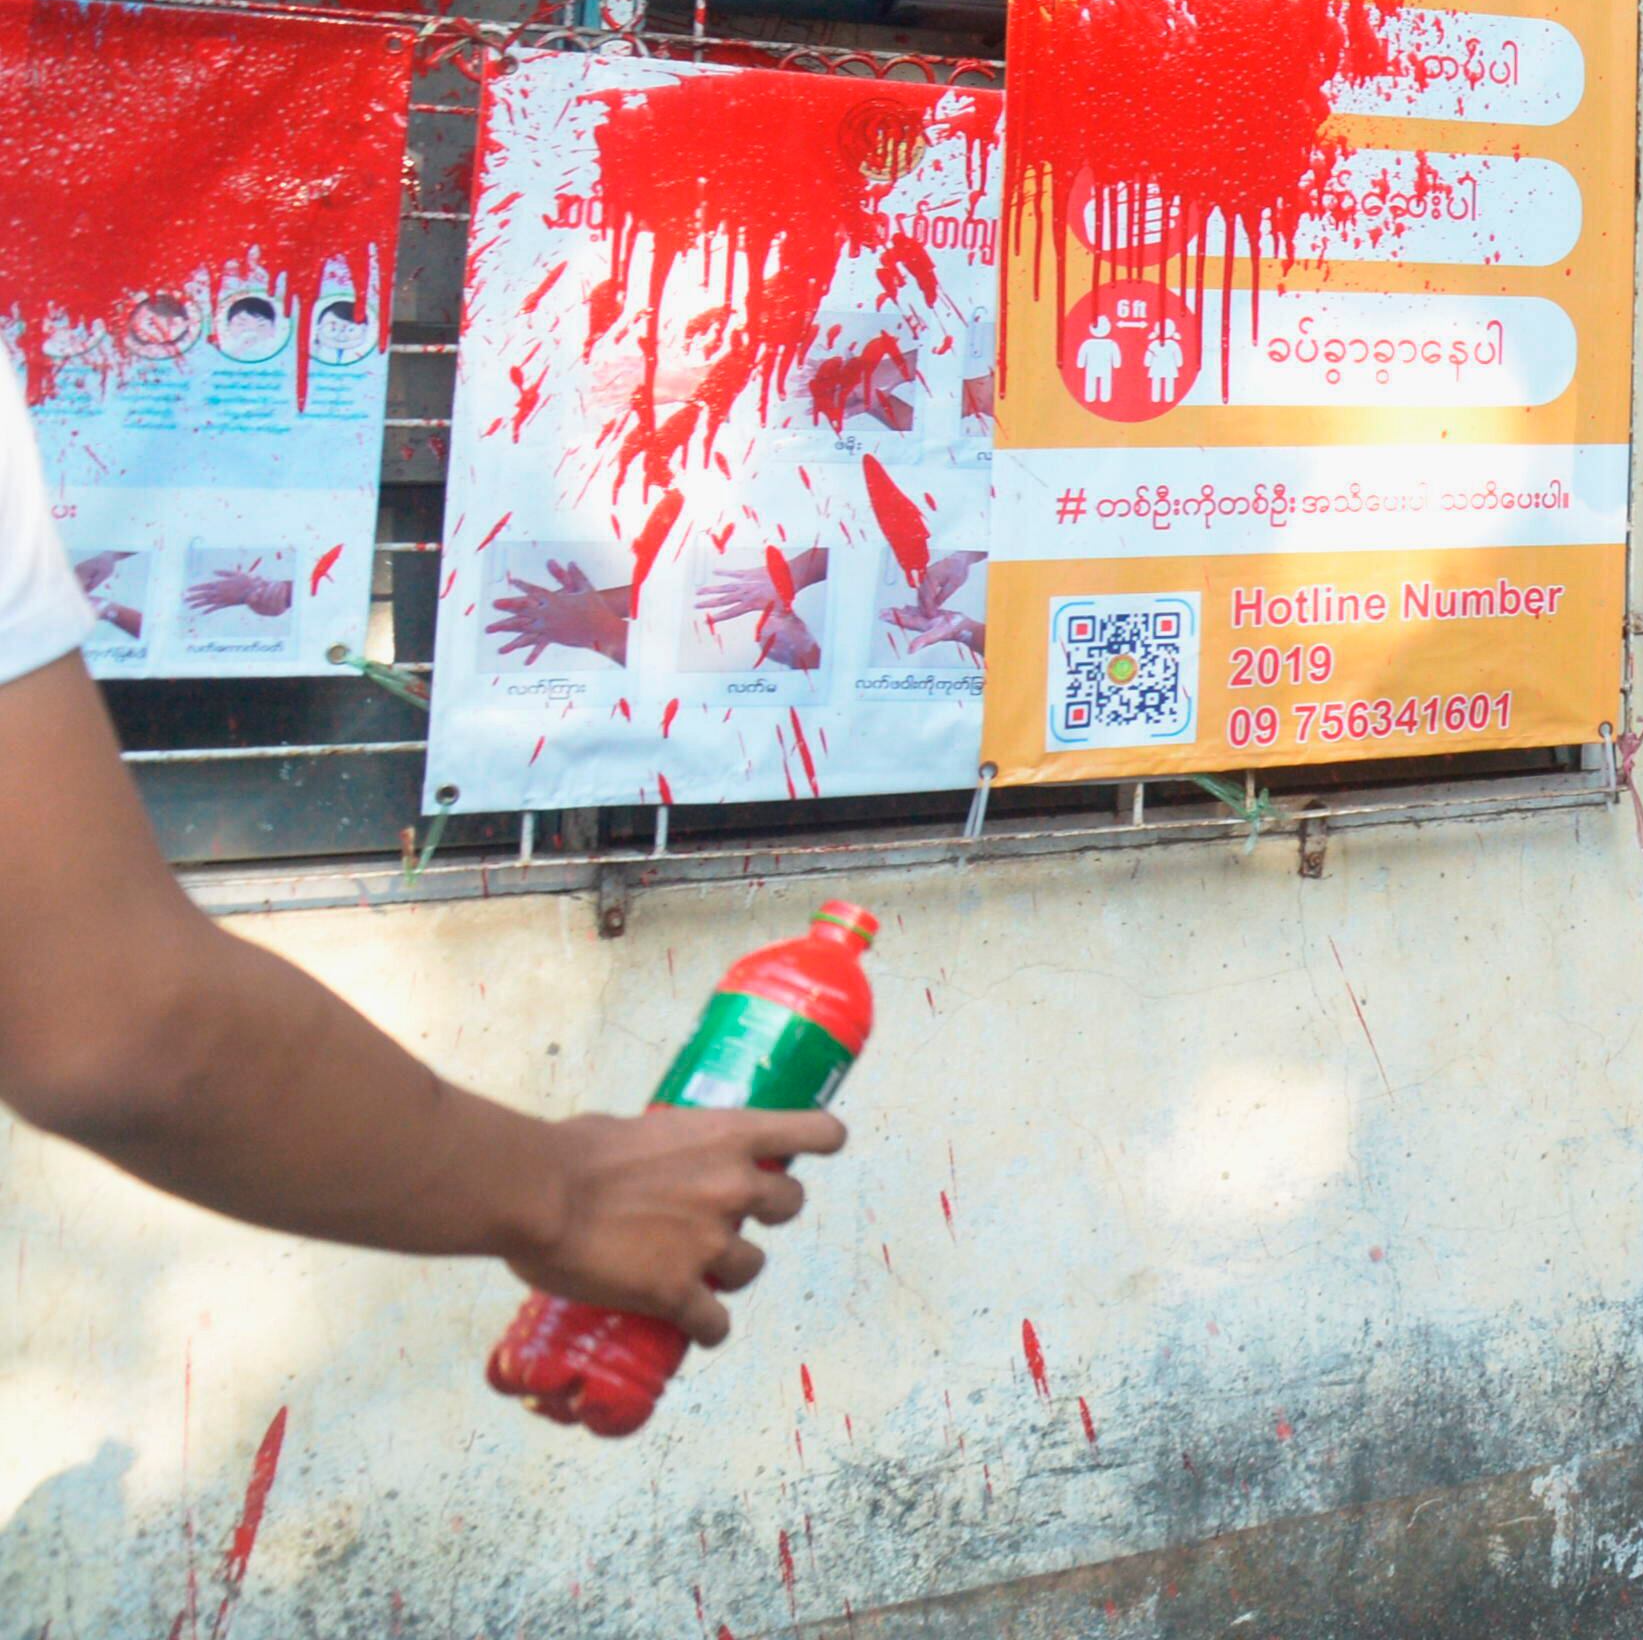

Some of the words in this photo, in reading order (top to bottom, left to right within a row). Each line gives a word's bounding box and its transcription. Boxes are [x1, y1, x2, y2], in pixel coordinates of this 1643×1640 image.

[1232, 586, 1386, 627] Hotline
[1404, 579, 1563, 618] Number
[1230, 645, 1332, 686] 2019
[1229, 706, 1278, 746] 09
[1294, 692, 1511, 742] 756341601
